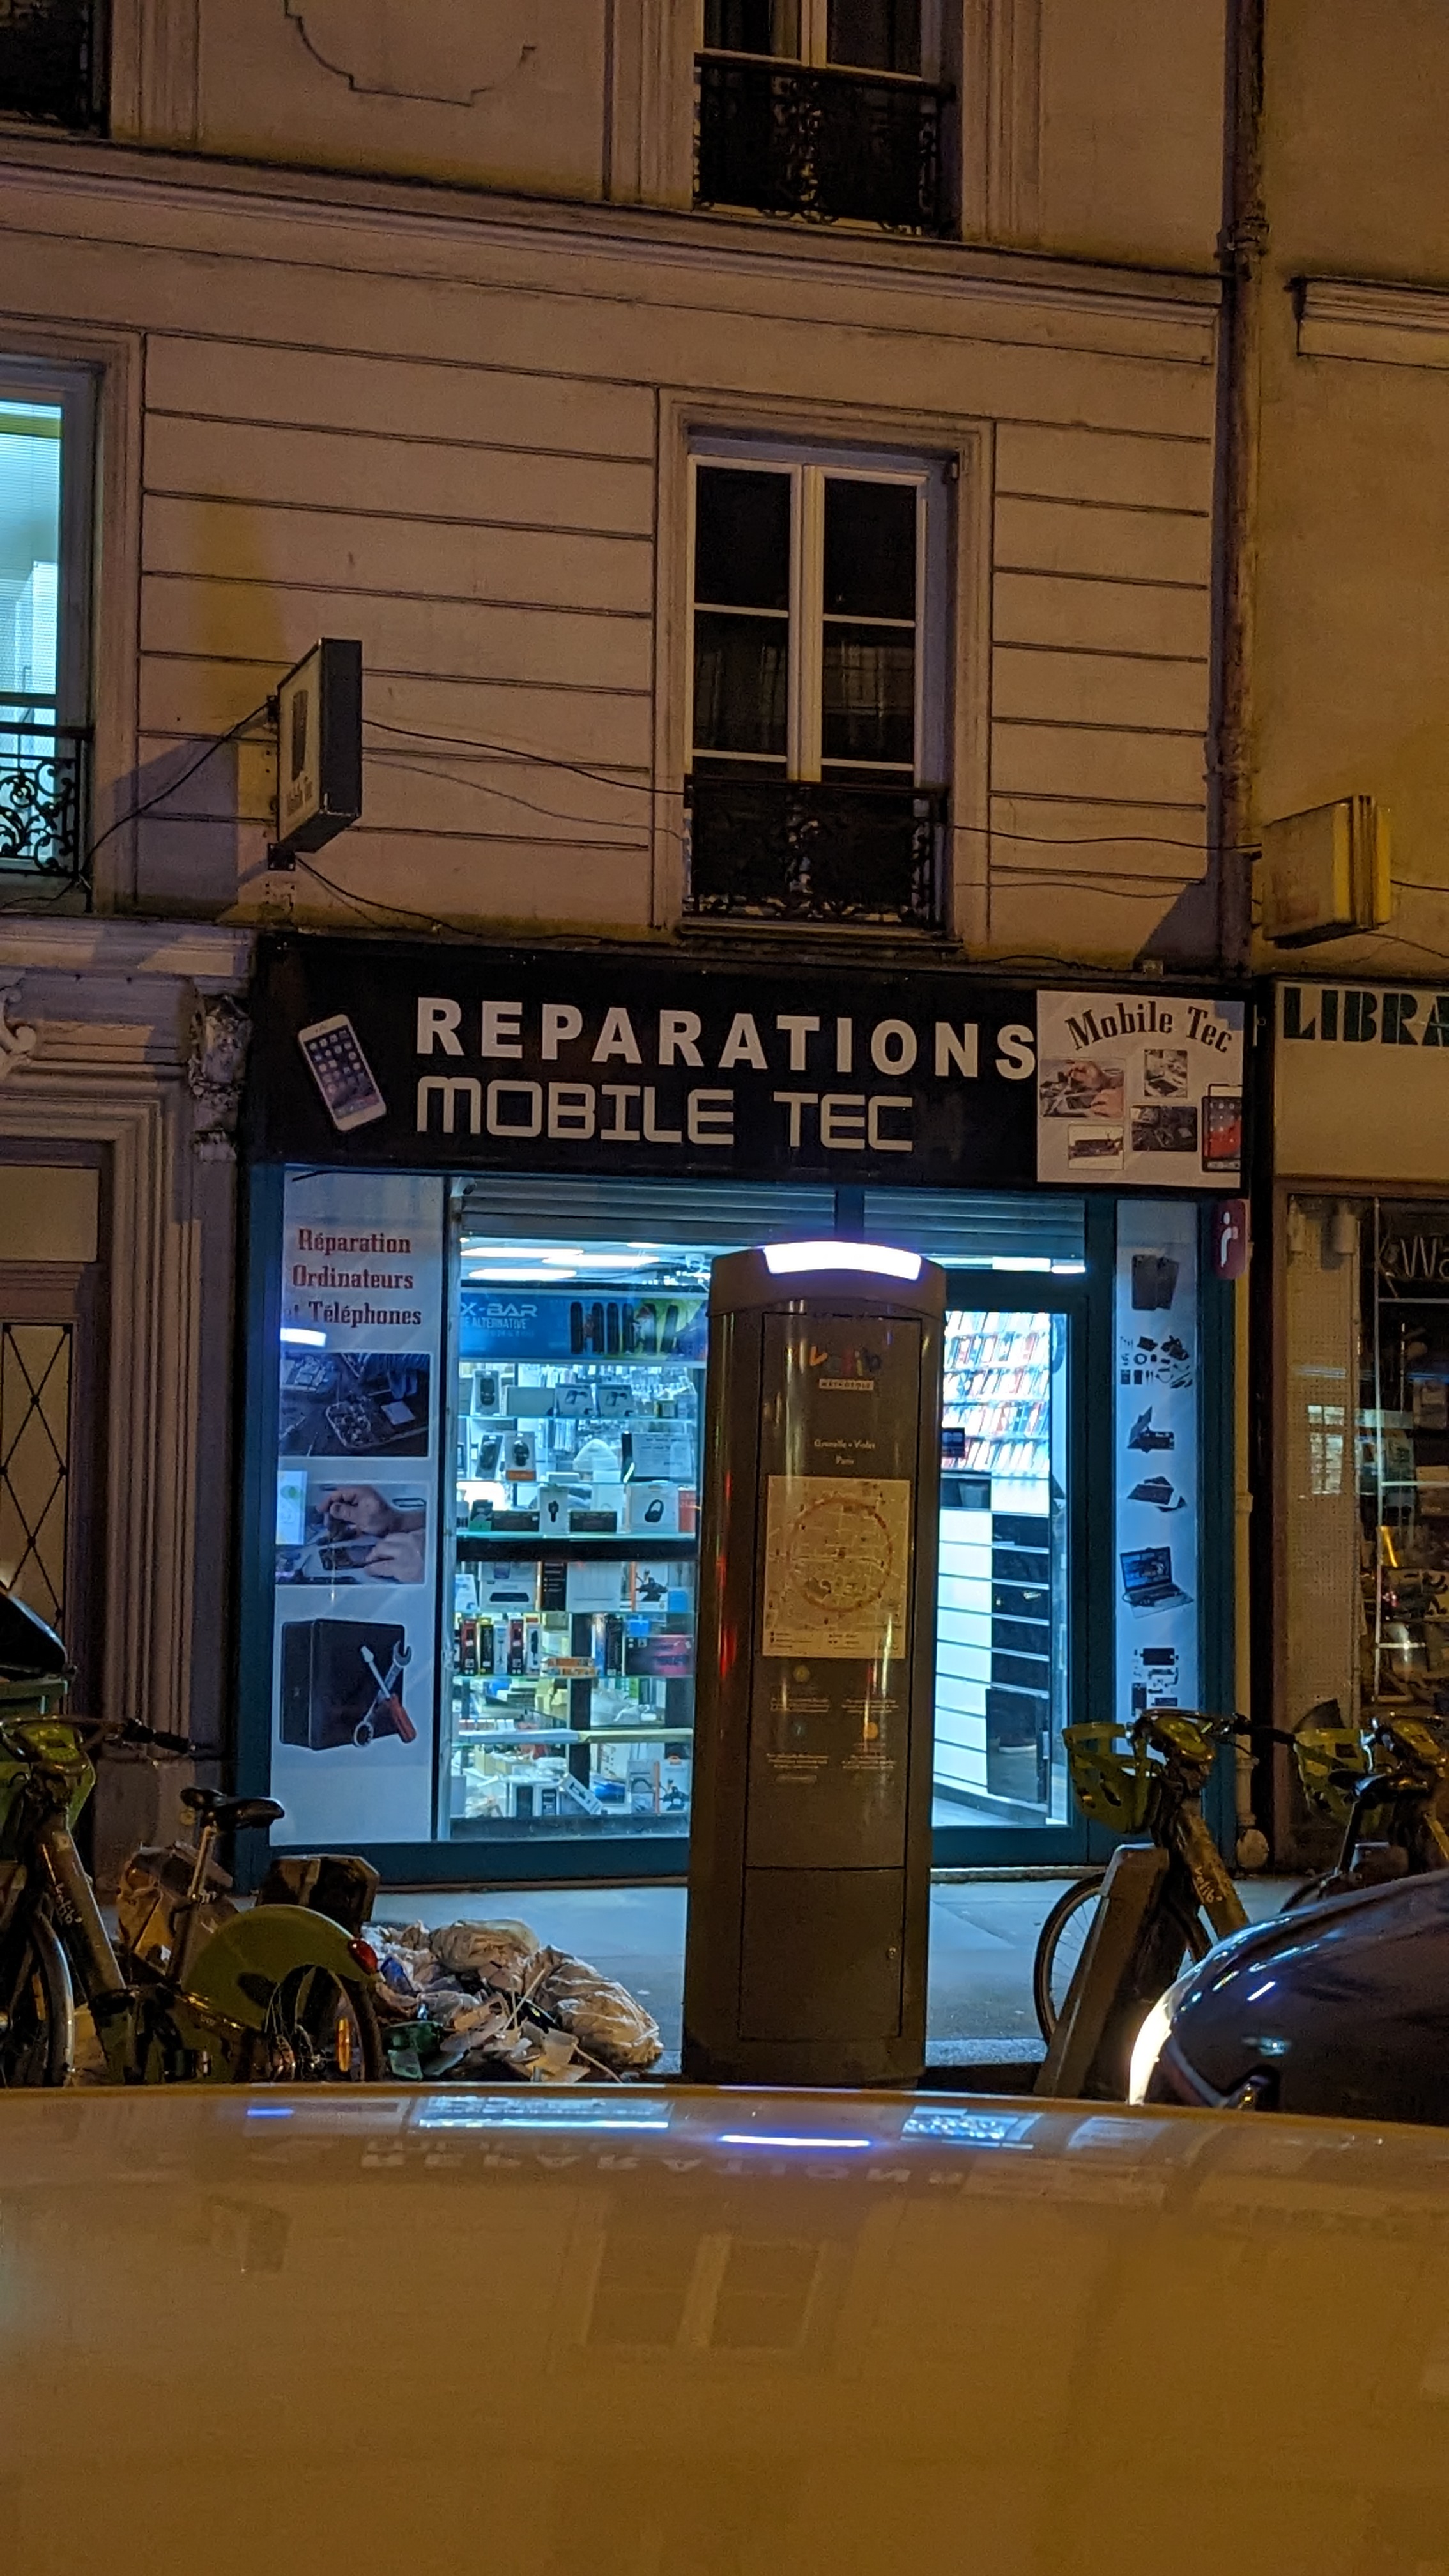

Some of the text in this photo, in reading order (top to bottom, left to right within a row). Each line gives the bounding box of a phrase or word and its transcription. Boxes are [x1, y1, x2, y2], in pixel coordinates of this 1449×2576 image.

[417, 996, 1036, 1080] REPARATIONS
[1064, 1000, 1233, 1054] Mobile Tec
[417, 1076, 913, 1151] MOBILE TEC
[298, 1227, 411, 1256] Réparation
[292, 1264, 414, 1289] Ordinateurs
[308, 1300, 422, 1328] Téléphones
